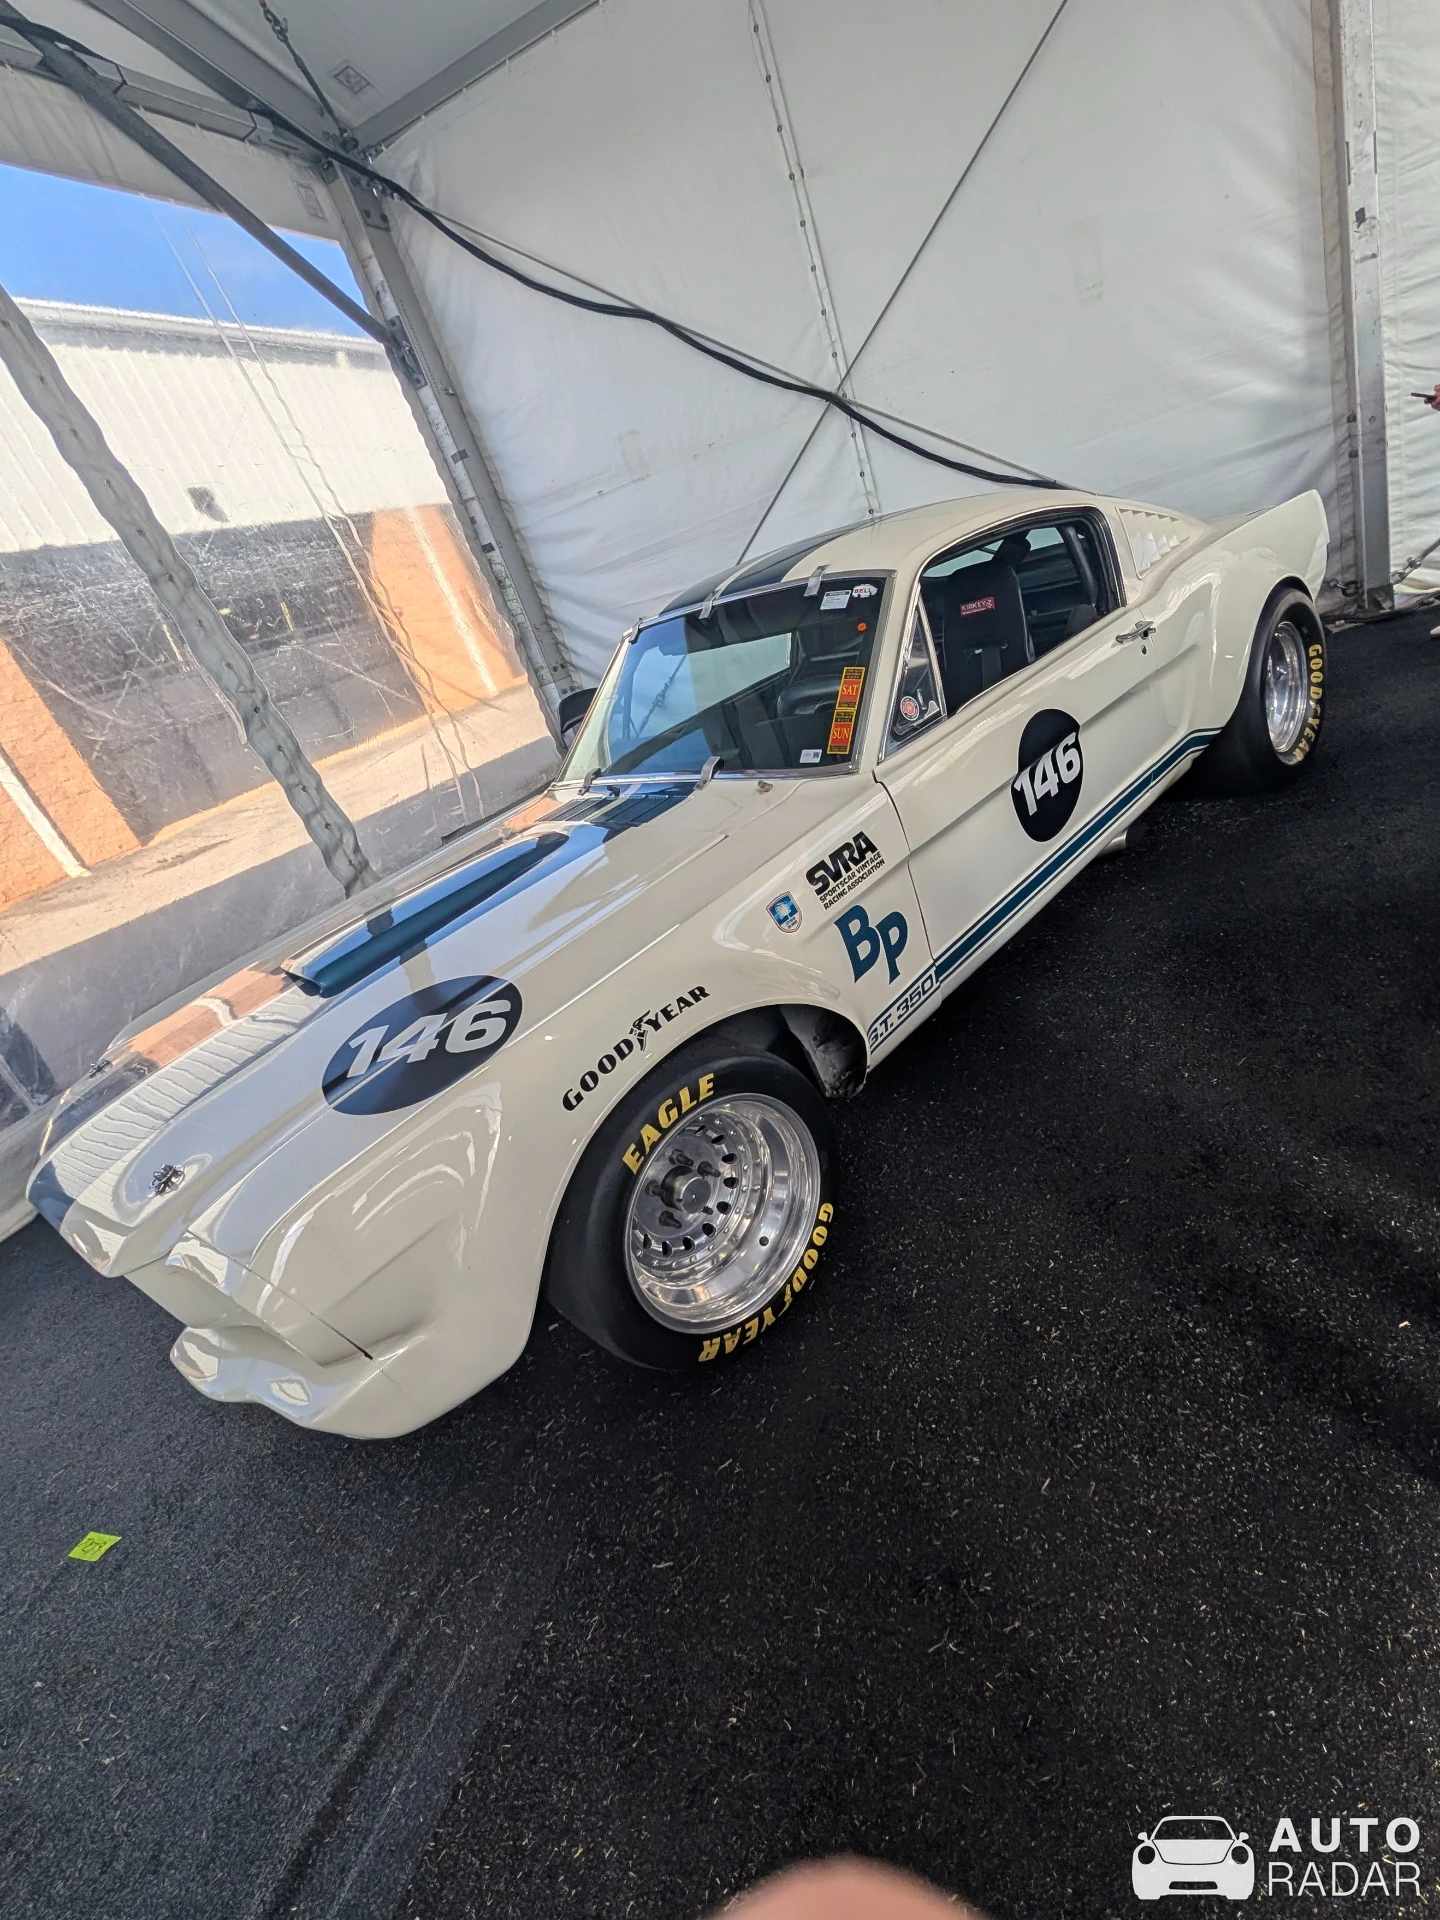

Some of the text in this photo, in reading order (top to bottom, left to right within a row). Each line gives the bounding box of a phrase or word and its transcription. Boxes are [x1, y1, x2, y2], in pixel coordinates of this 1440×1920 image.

[961, 600, 986, 611] KIRKEY
[842, 684, 858, 695] SAT
[1292, 644, 1323, 762] GOODYEAR
[833, 727, 850, 738] SUN
[1013, 731, 1080, 817] 146
[805, 830, 878, 896] SVRA
[819, 851, 882, 903] SPORTSCAR VINTAGE
[823, 858, 885, 911] RACING ASSOCIATION
[348, 999, 512, 1078] 146
[868, 973, 934, 1049] G.T. 350
[622, 1073, 715, 1175] EAGLE
[698, 1202, 834, 1363] GOODYEAR
